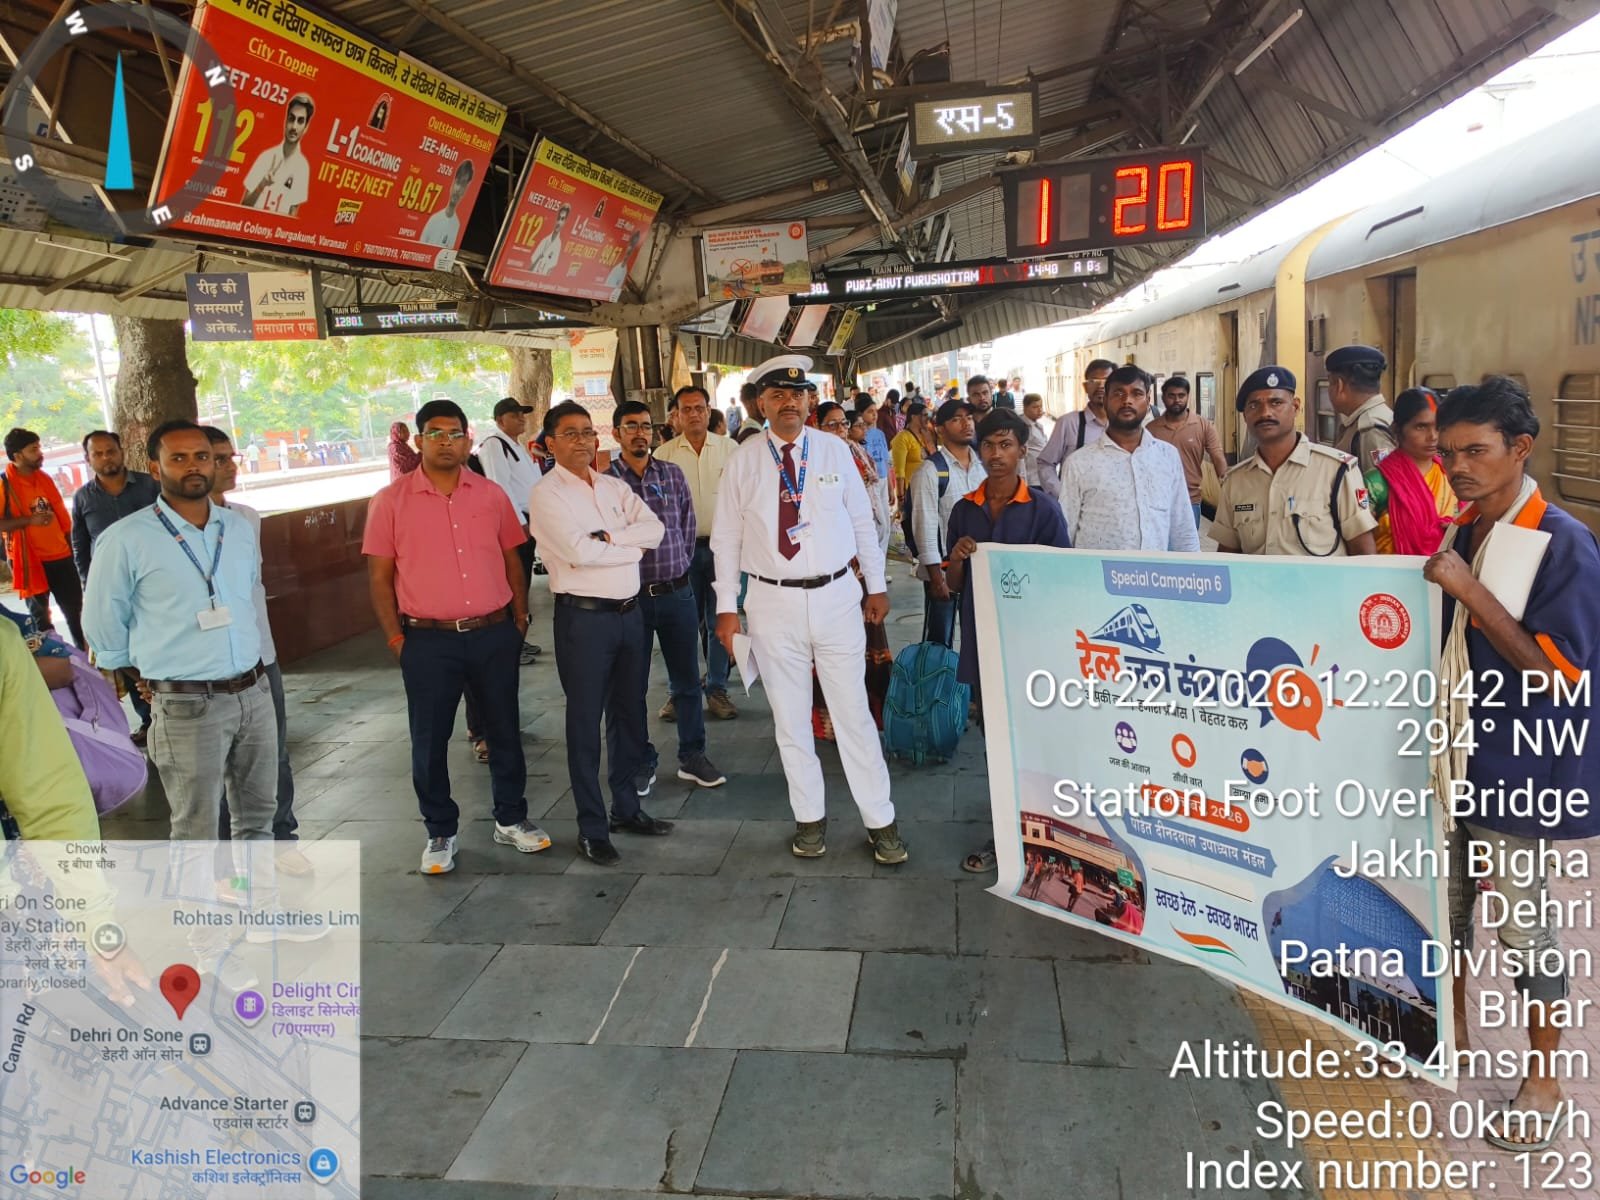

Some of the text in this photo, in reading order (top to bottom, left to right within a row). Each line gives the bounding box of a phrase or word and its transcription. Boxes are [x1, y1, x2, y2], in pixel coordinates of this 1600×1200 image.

[272, 4, 310, 37] देखिए
[311, 23, 346, 53] सफल
[248, 37, 319, 79] City Topper
[251, 76, 289, 105] 2025
[193, 97, 255, 164] 112
[326, 117, 402, 173] L-1 COACHING
[428, 116, 493, 152] Outstanding Result
[419, 136, 459, 162] JEE-Main
[398, 175, 443, 214] 99.67
[527, 191, 544, 206] NEET
[1113, 160, 1193, 236] 20
[183, 212, 241, 231] Brahmanand
[243, 221, 272, 238] Colony,
[319, 235, 349, 249] Varanasi
[334, 211, 356, 225] OPEN
[514, 212, 544, 248] 112
[871, 264, 914, 275] TRAIN NAME
[905, 270, 979, 289] PURUSHOTTAM
[221, 278, 238, 294] की
[271, 288, 305, 302] एपेक्स
[334, 316, 363, 327] 12801
[399, 303, 437, 312] TRAIN NAME
[255, 322, 316, 337] समाधान एक
[1111, 570, 1223, 596] Special Campaign 6
[1075, 629, 1121, 684] रेल
[1200, 709, 1249, 732] बेहतर कल
[1155, 820, 1267, 870] दीनदयाल उपाध्याय मंडल
[1154, 888, 1179, 912] स्वच्छ
[1180, 891, 1196, 917] रेल
[1205, 904, 1231, 930] स्वच्छ
[1233, 915, 1259, 942] भारत
